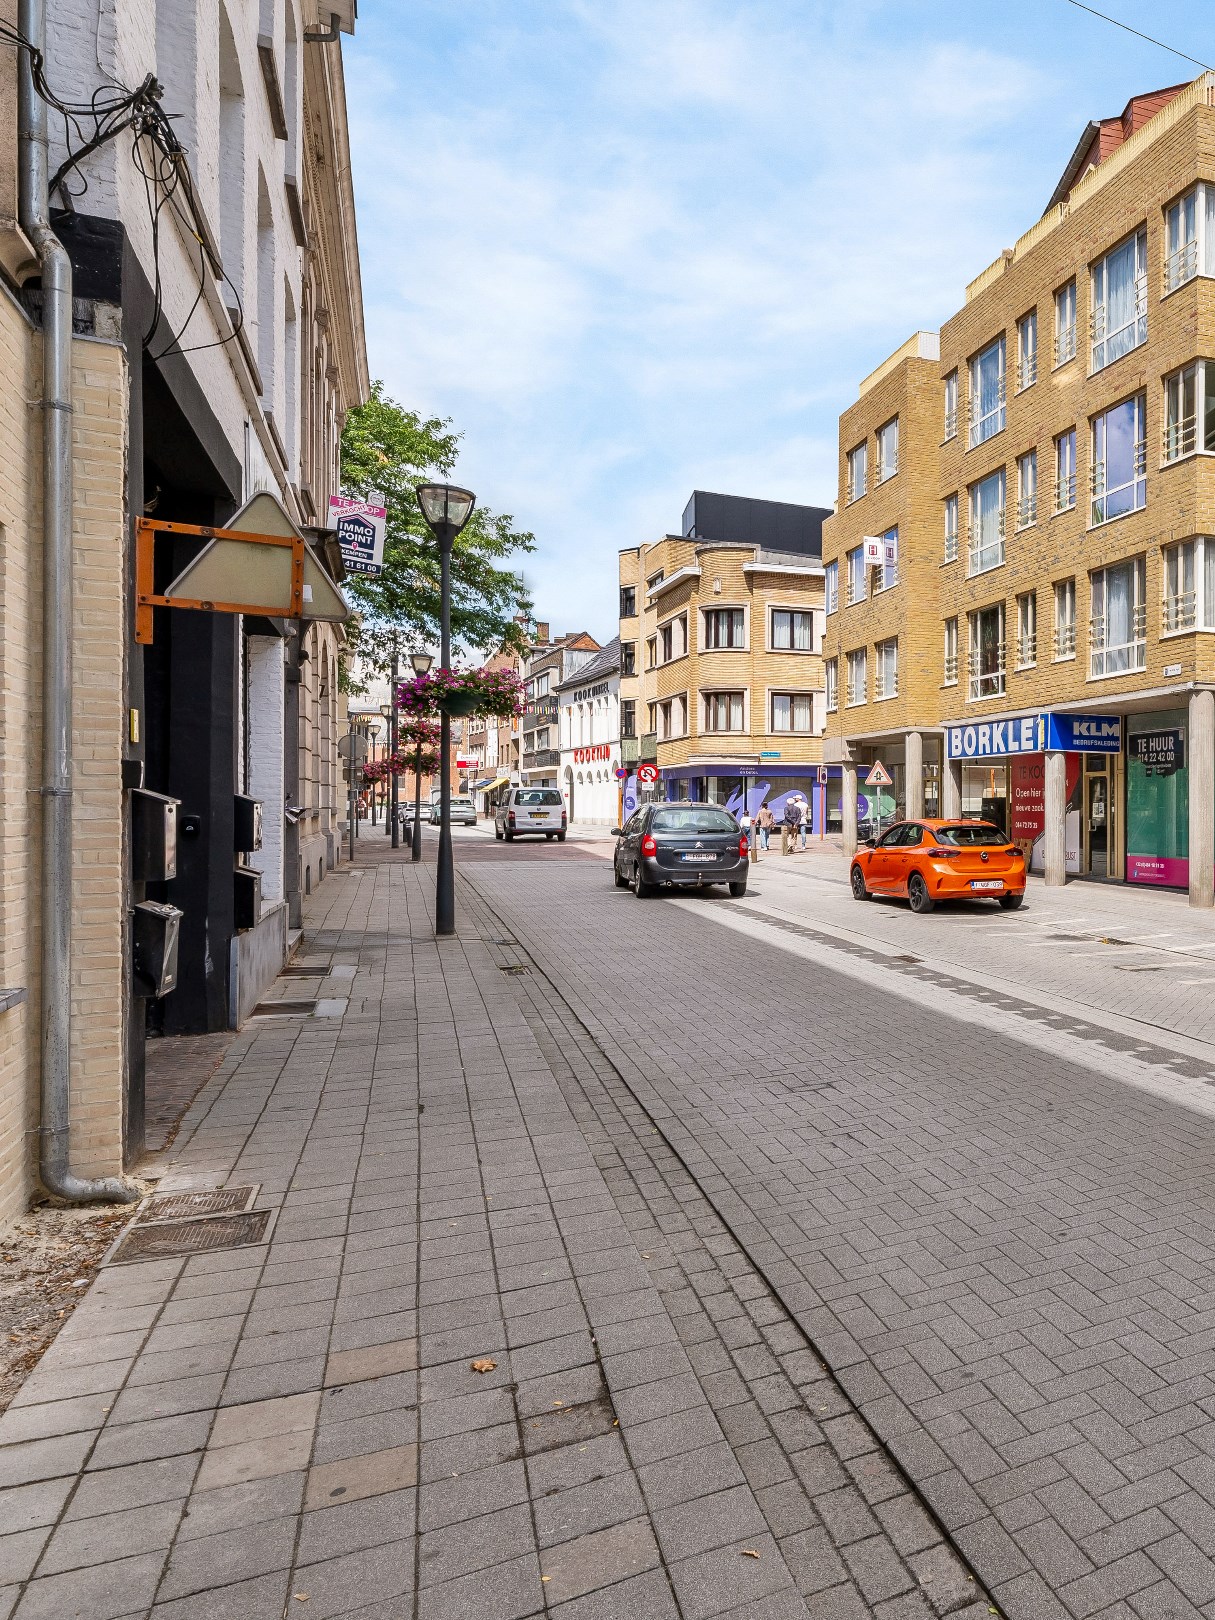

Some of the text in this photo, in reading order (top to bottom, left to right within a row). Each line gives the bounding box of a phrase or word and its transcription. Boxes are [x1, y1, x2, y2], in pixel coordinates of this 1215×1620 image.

[332, 505, 367, 517] VERKOCHT
[340, 522, 373, 536] IMMO
[339, 531, 373, 544] POINT
[341, 548, 368, 558] KEMPEN
[1073, 721, 1119, 737] KLM
[1138, 736, 1174, 752] TE HUUR
[1150, 753, 1157, 762] 22
[1158, 752, 1165, 761] 42
[1166, 752, 1174, 761] 00
[1029, 765, 1045, 778] KOO
[1016, 788, 1029, 798] Open
[1031, 788, 1041, 797] hier
